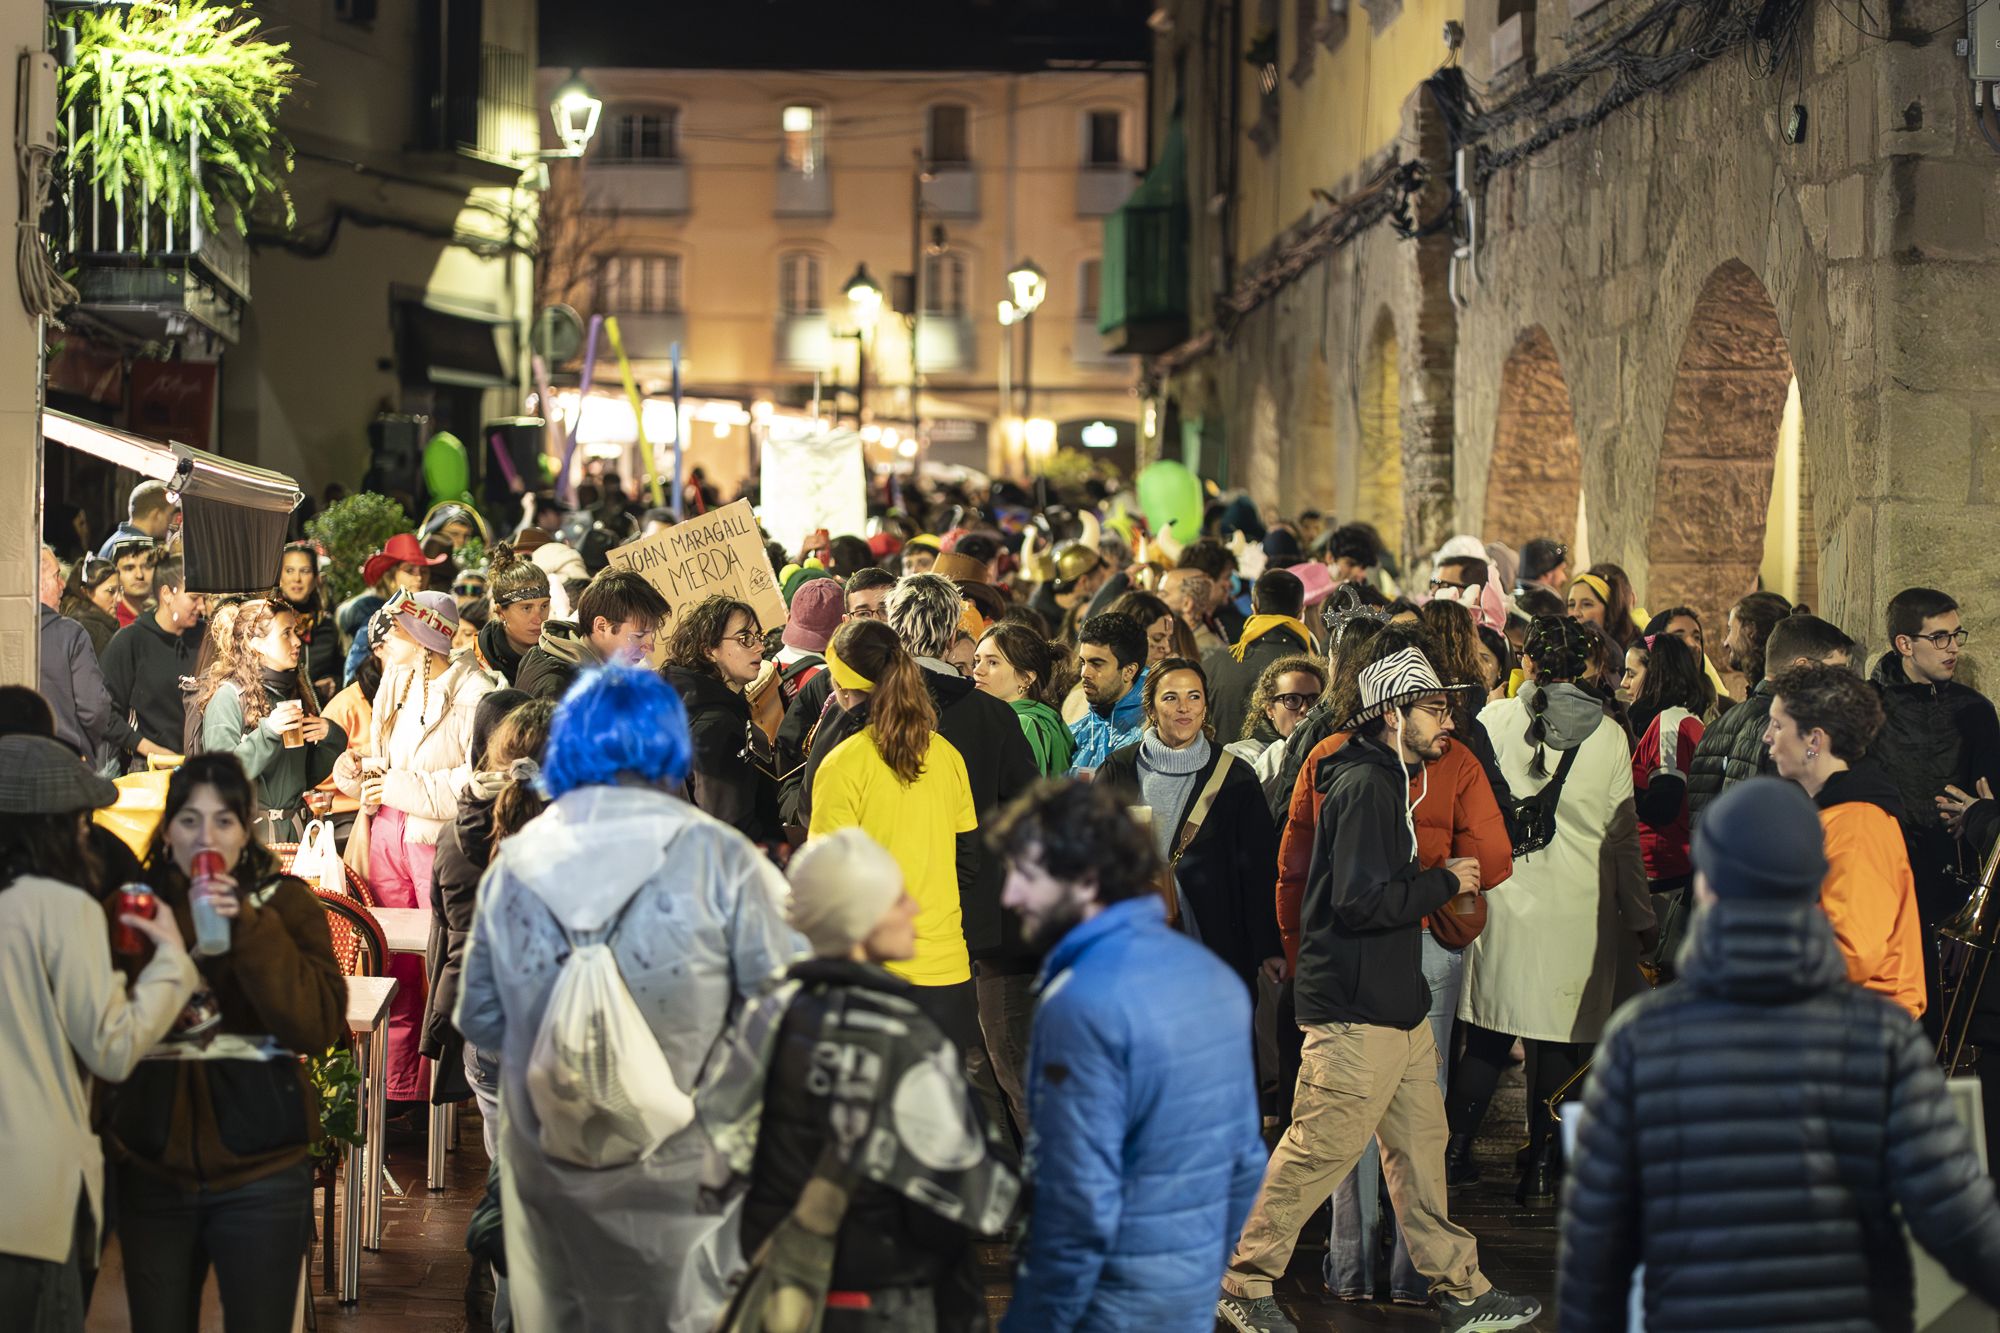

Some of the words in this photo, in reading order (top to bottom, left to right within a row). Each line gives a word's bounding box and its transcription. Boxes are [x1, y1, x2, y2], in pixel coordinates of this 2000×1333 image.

[616, 542, 667, 573] JOAN
[671, 515, 750, 553] MARAGALL
[668, 543, 745, 597] MERDA
[400, 600, 457, 640] Ethe
